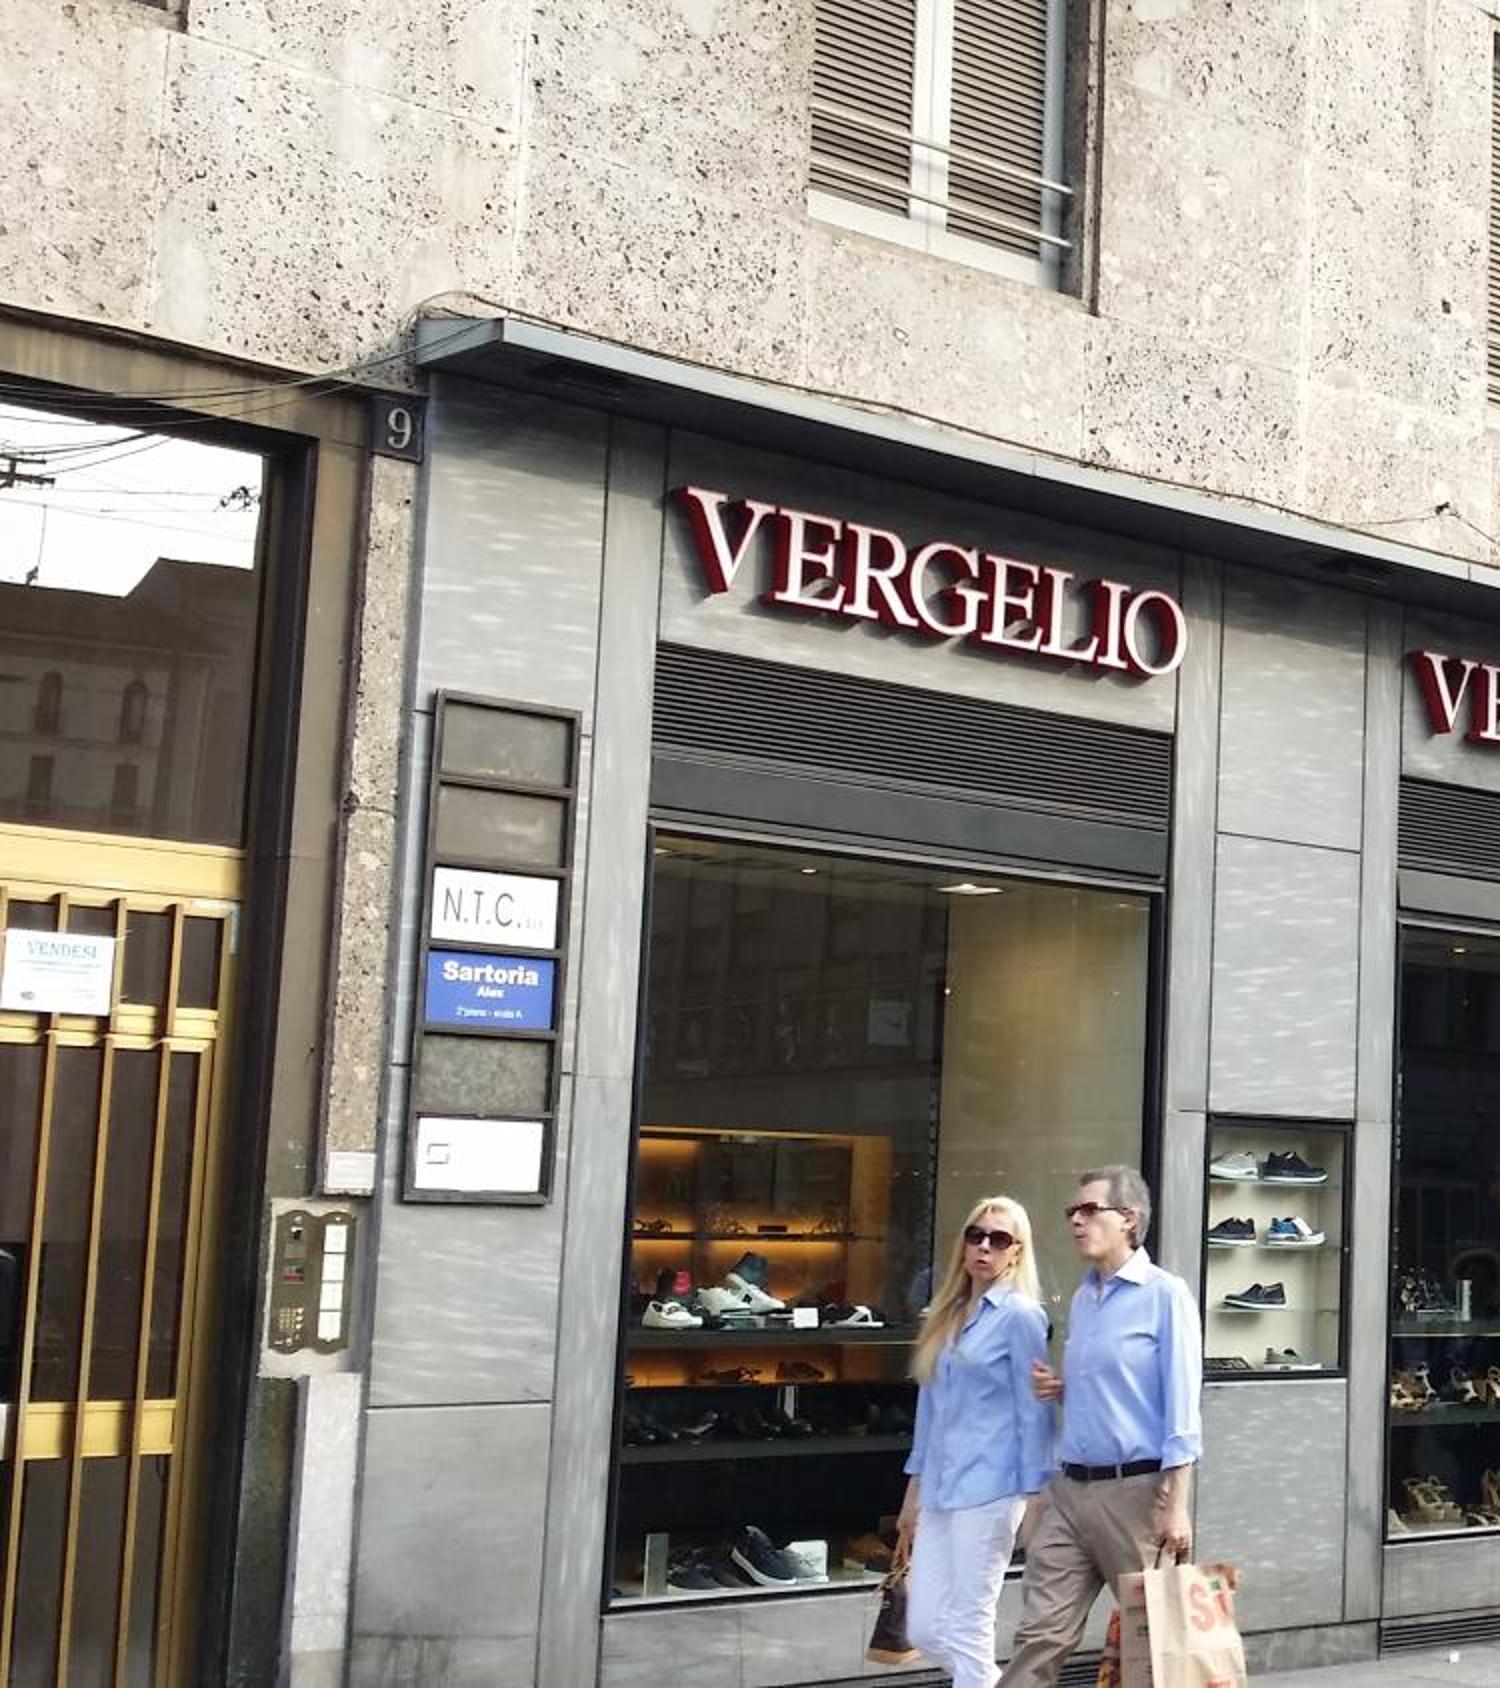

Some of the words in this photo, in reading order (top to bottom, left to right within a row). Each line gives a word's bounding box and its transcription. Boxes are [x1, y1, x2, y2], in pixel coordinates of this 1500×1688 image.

[387, 407, 411, 449] 9
[683, 484, 1188, 678] VERGELIO
[26, 939, 97, 960] VENDESI
[441, 960, 540, 987] Sartoria
